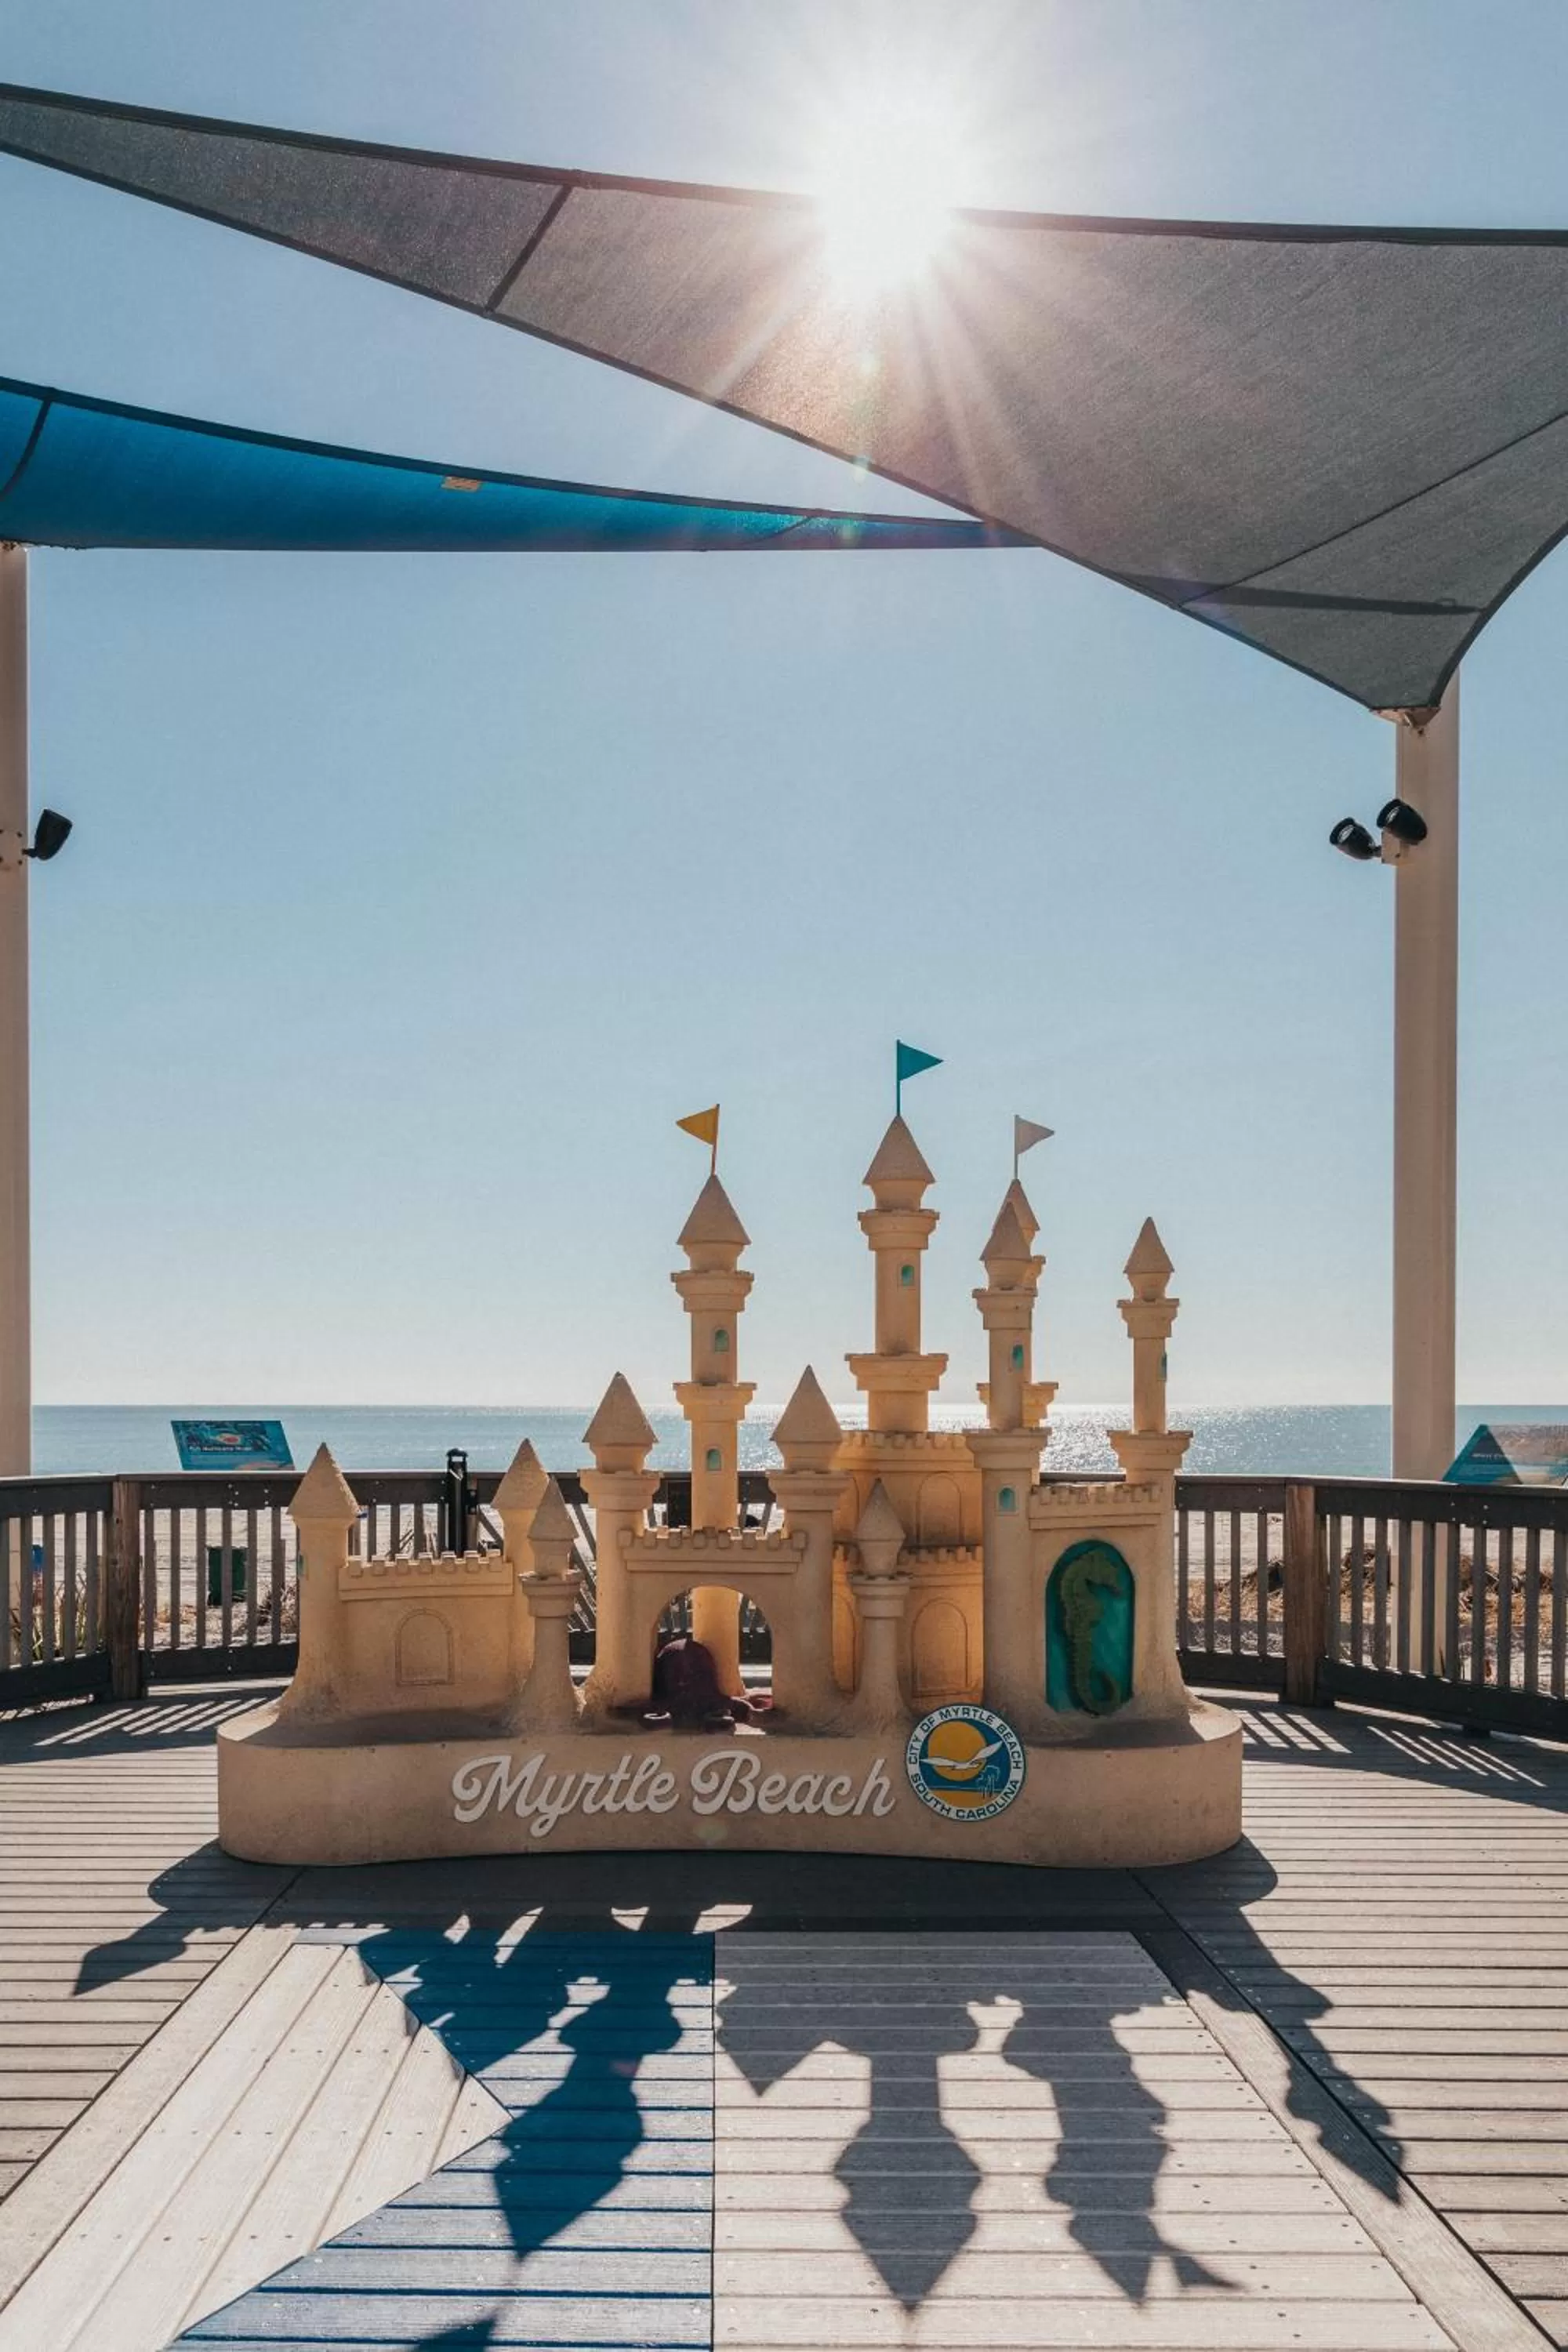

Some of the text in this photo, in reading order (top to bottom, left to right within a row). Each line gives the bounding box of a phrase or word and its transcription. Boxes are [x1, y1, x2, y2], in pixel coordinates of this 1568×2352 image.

[909, 1707, 1022, 1769] CITY OF MYRTLE BEACH
[452, 1749, 896, 1838] Myrtle Beach
[911, 1773, 1020, 1819] SOUTH CAROLINA
